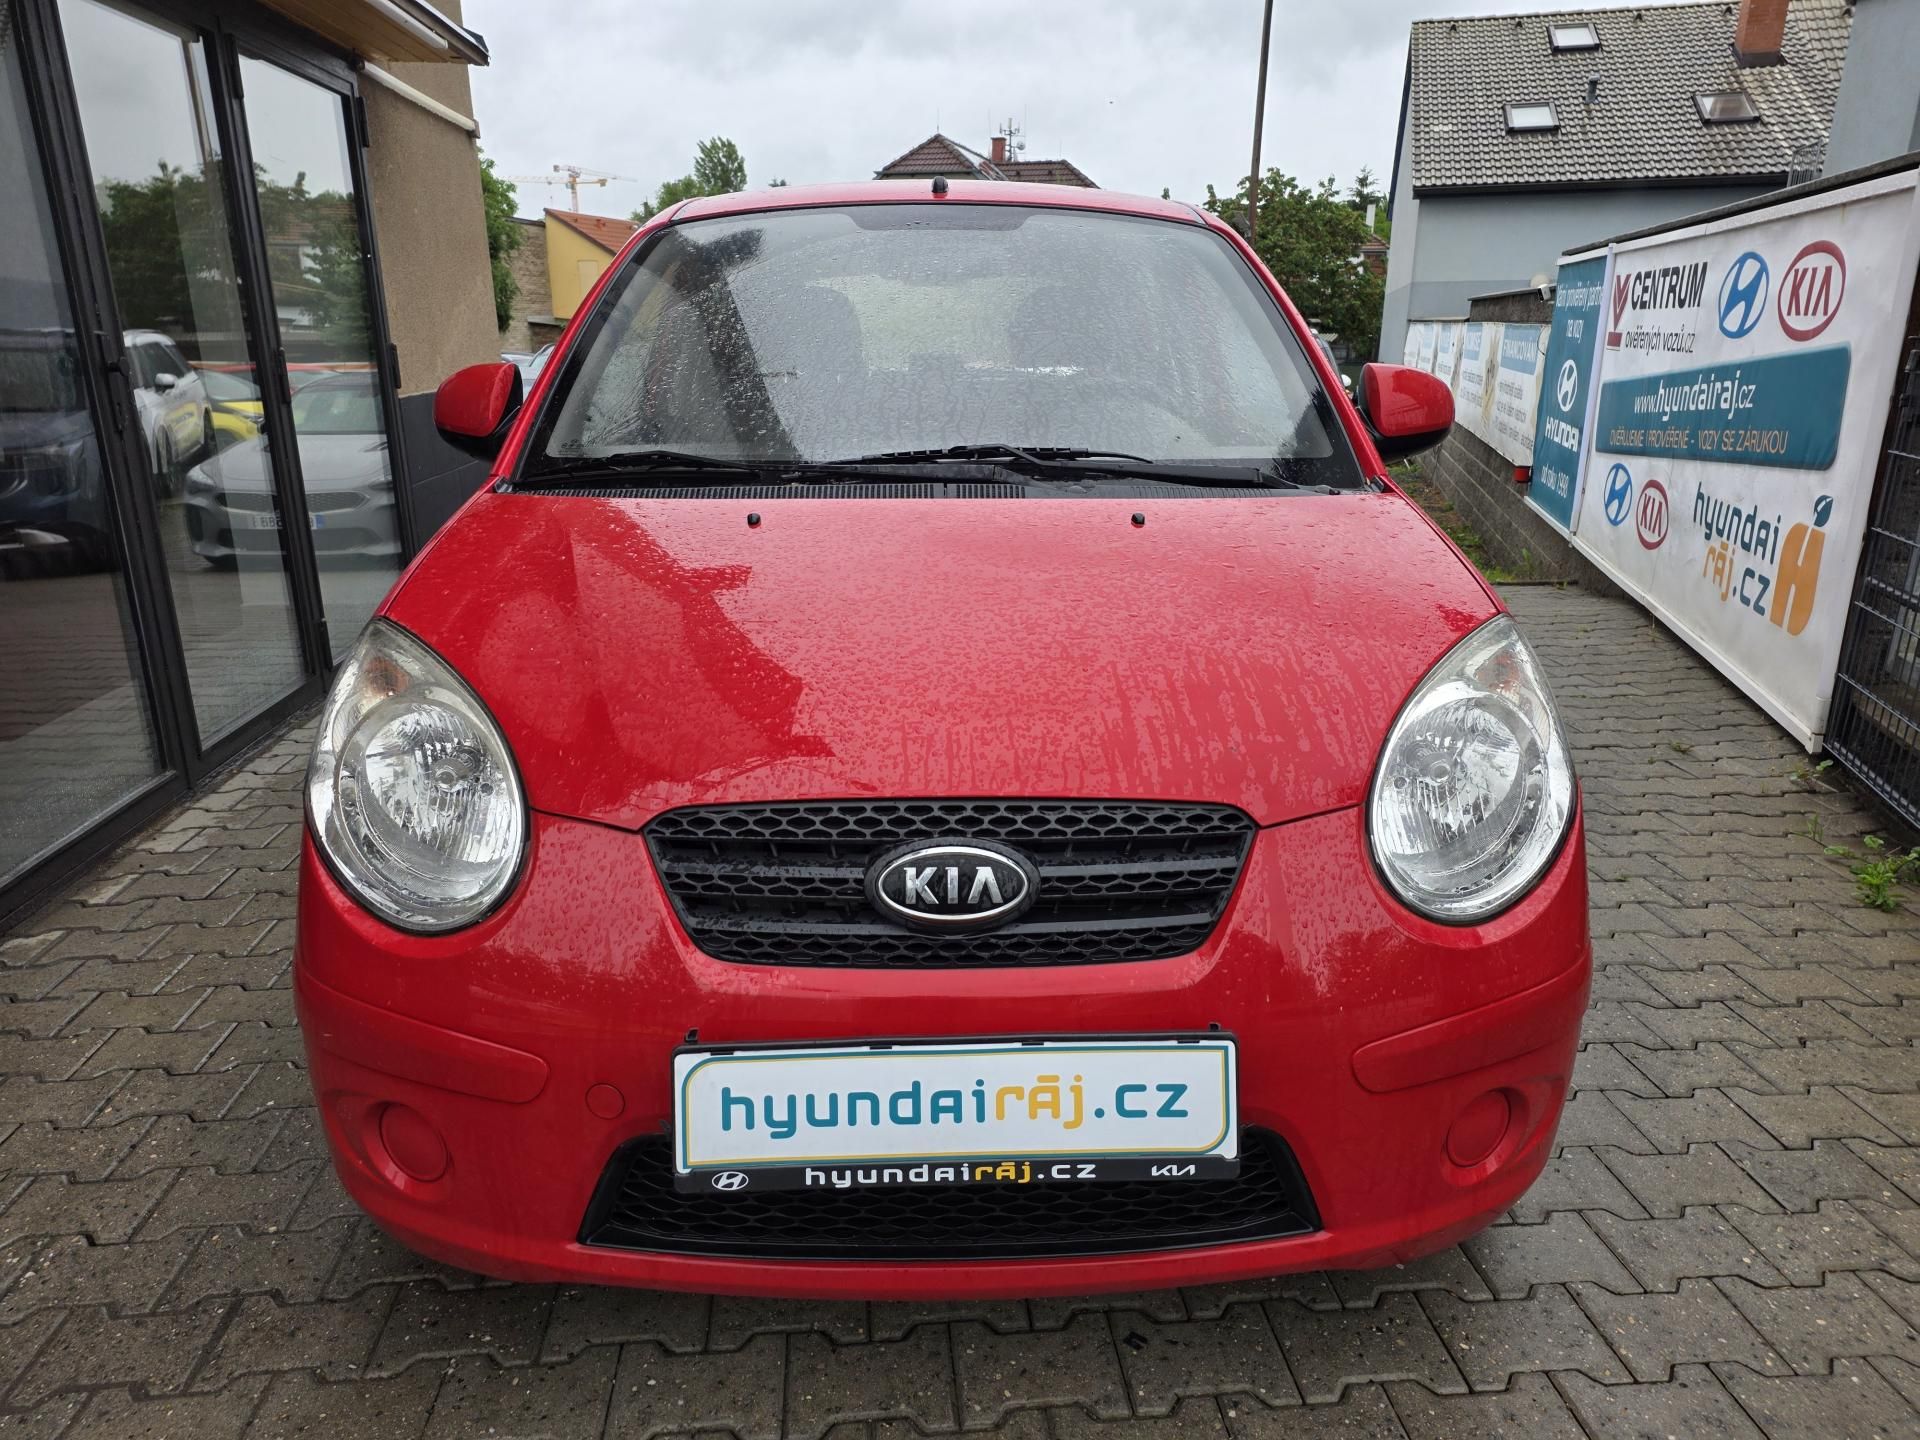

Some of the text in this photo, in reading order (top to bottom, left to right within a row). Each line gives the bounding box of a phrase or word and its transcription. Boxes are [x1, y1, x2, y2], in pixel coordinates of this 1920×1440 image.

[1631, 261, 1708, 311] CENTRUM
[1566, 319, 1574, 338] na
[1625, 323, 1696, 356] ověřených vozů.cz
[1634, 369, 1756, 422] www.hyundairaj.cz
[1545, 415, 1580, 453] HYUNDAI
[1721, 429, 1736, 451] SE
[1736, 424, 1789, 454] ZÁRUKOU
[903, 866, 1004, 905] KIA
